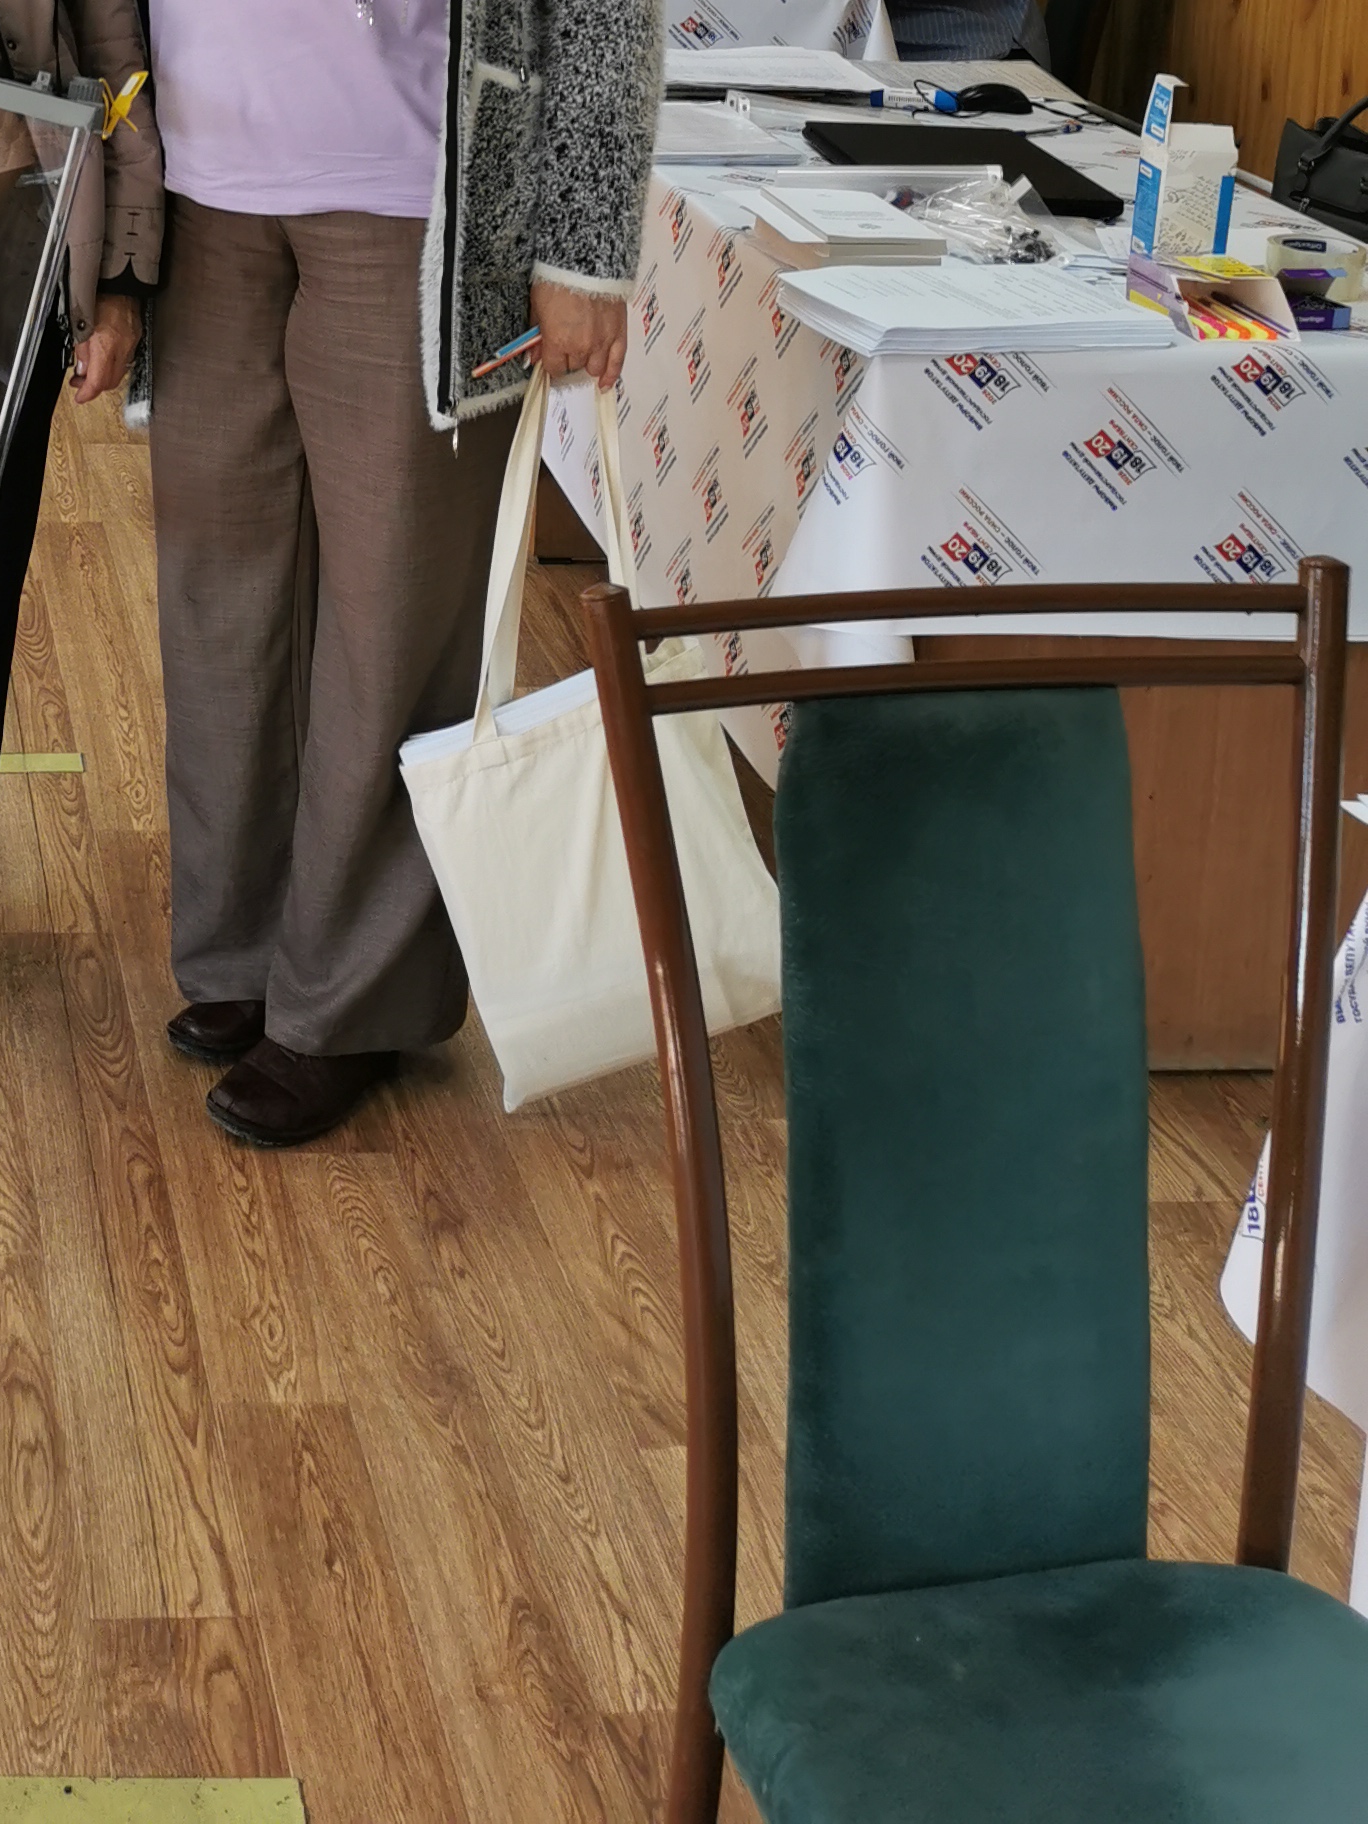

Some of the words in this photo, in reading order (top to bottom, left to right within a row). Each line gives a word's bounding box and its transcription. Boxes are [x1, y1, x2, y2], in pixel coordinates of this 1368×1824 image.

[974, 364, 988, 383] 19
[1012, 352, 1036, 376] ГОЛОС
[1239, 359, 1261, 380] 20
[924, 367, 959, 404] ДЕПУТАТОВ
[993, 374, 1011, 392] 18
[1031, 372, 1050, 393] ТВОЙ
[1260, 372, 1276, 390] 19
[1279, 381, 1296, 400] 18
[835, 439, 849, 458] 19
[867, 430, 890, 453] ГОЛОС
[1091, 435, 1112, 456] 20
[1150, 435, 1170, 457] ГОЛОС
[850, 451, 865, 469] 18
[886, 451, 905, 470] ТВОЙ
[1111, 448, 1129, 465] 19
[1129, 456, 1146, 474] 18
[1167, 455, 1184, 474] ТВОЙ
[1062, 450, 1095, 485] ДЕПУТАТОВ
[984, 515, 1001, 533] СИЛА
[1261, 517, 1278, 535] СИЛА
[947, 537, 968, 559] 20
[1004, 537, 1025, 559] ГОЛОС
[1221, 539, 1242, 559] 20
[968, 550, 984, 569] 19
[986, 559, 1002, 576] 18
[1022, 557, 1040, 576] ТВОЙ
[1241, 550, 1257, 569] 19
[1259, 559, 1275, 577] 18
[1248, 1205, 1261, 1233] 18
